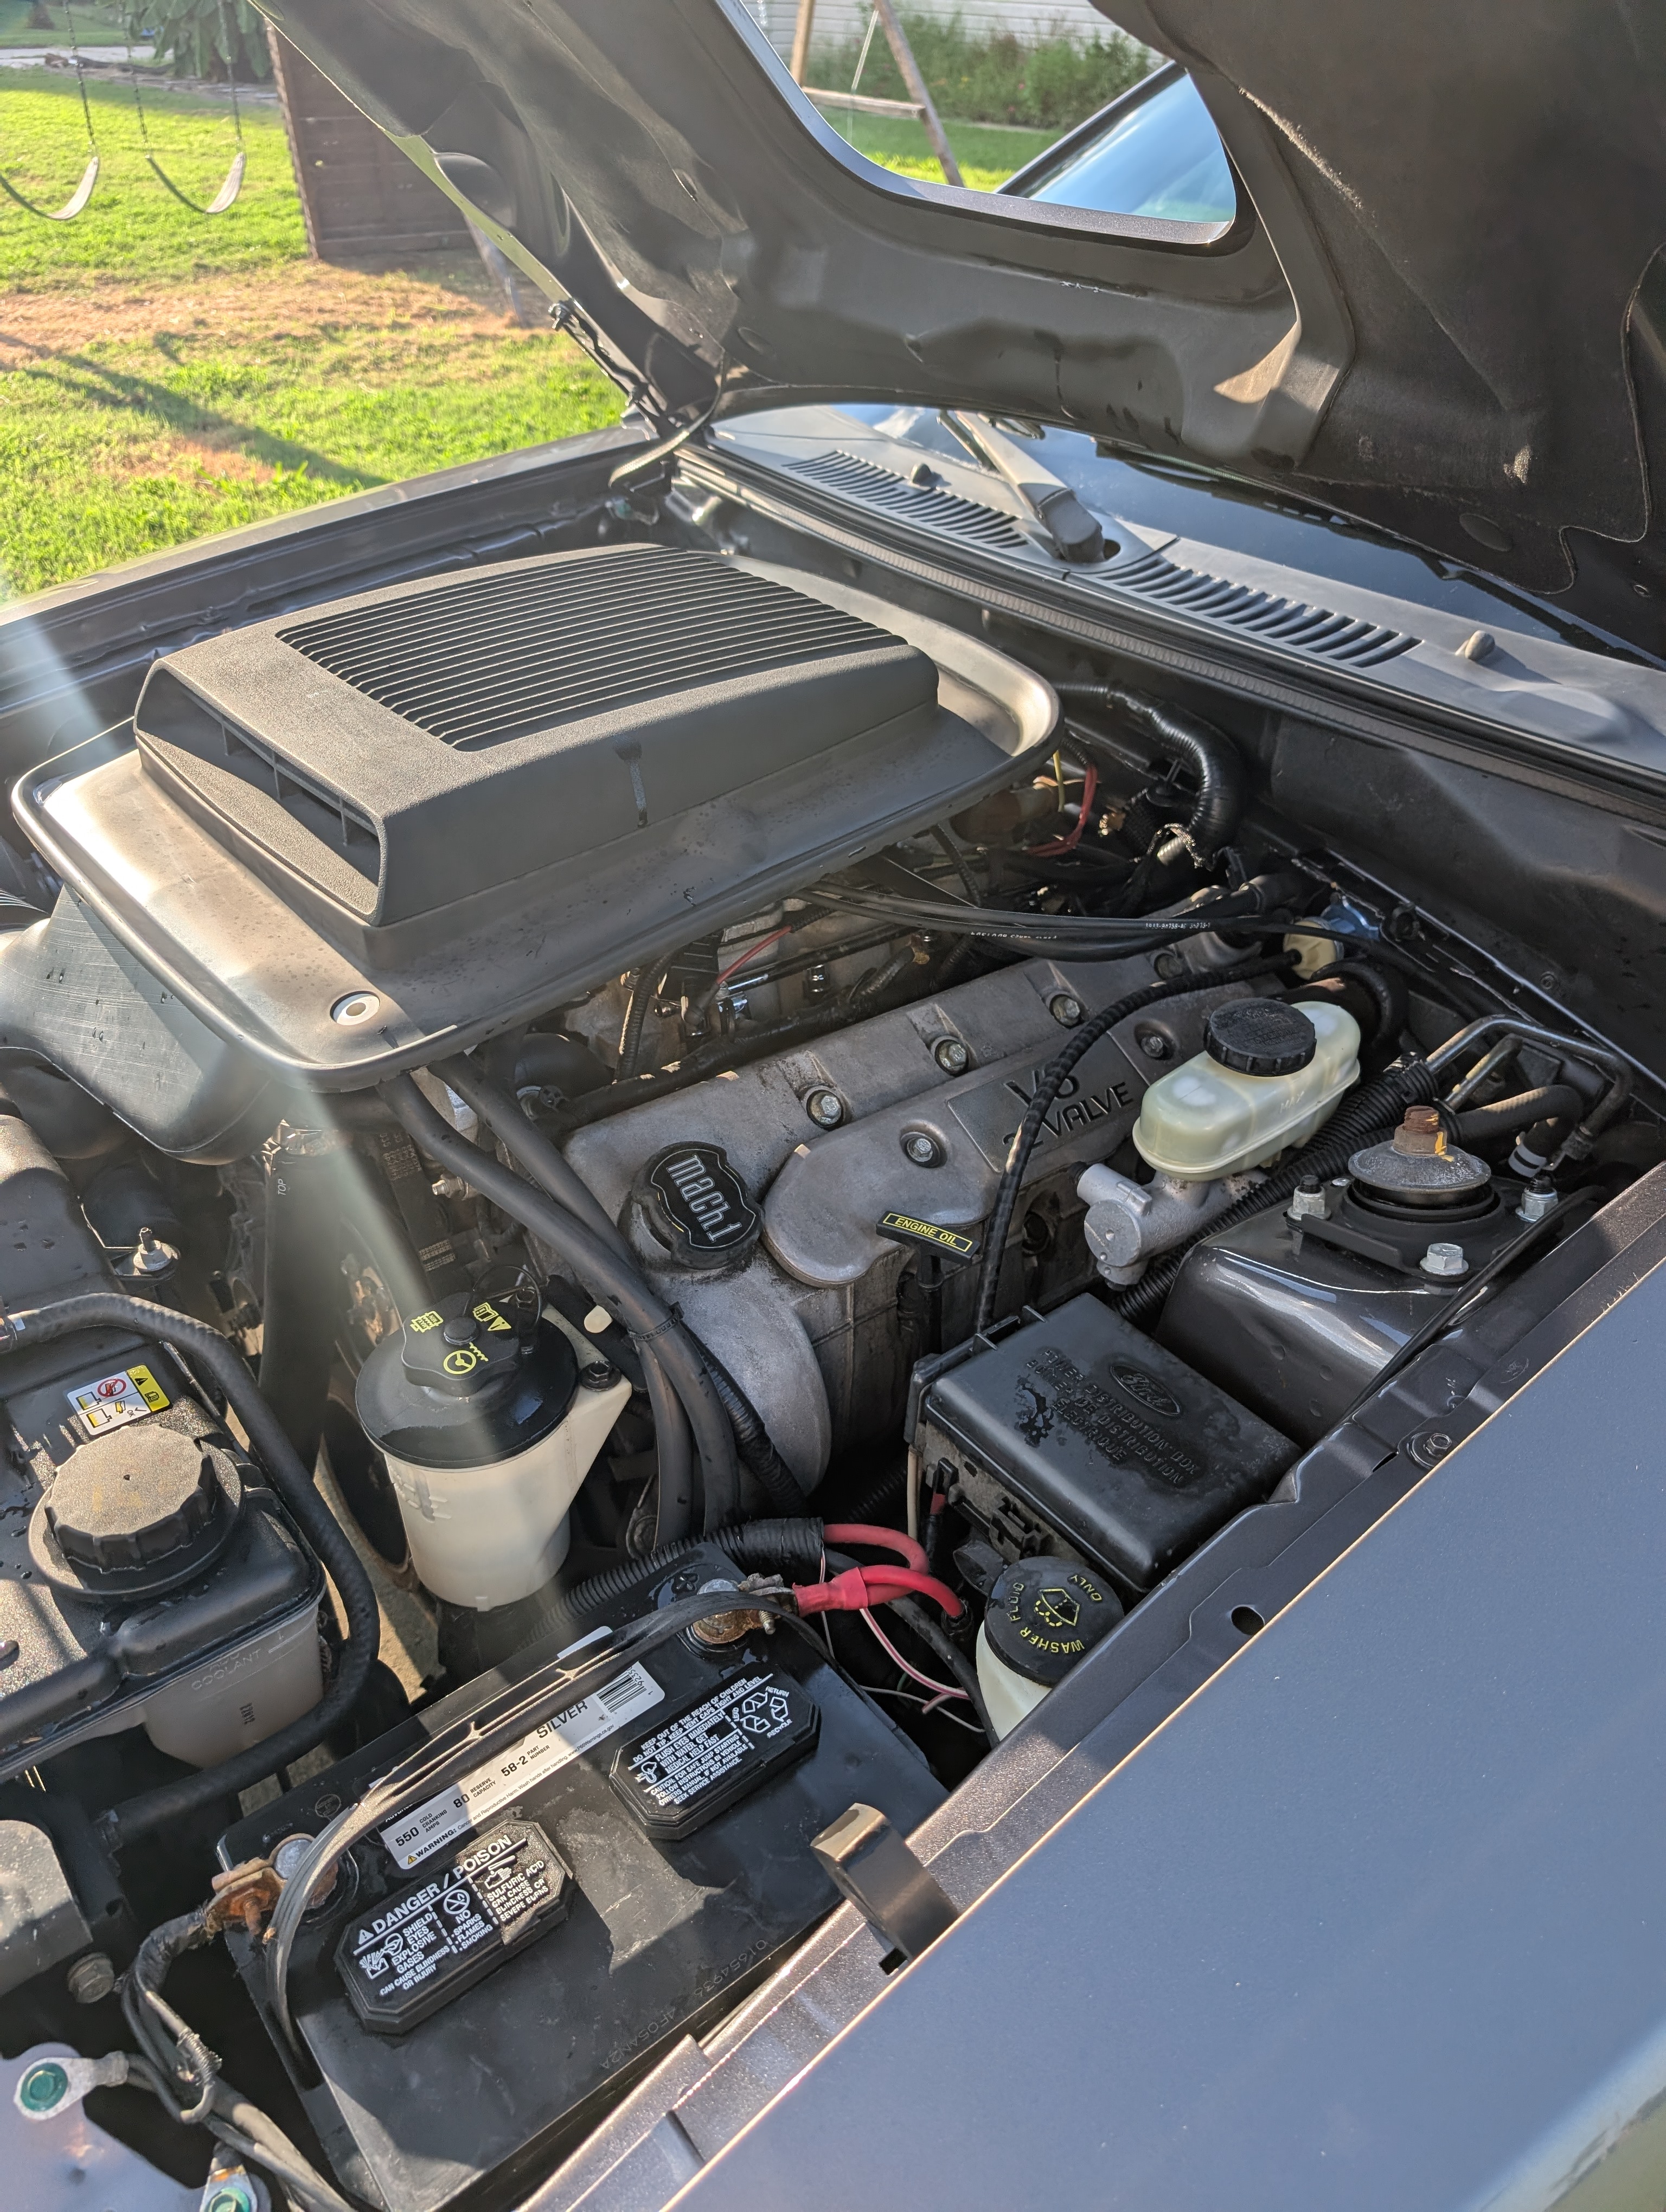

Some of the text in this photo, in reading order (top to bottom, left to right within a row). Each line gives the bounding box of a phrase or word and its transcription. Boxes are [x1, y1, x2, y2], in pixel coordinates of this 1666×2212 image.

[1040, 1082, 1133, 1137] VALVE
[275, 1178, 288, 1195] TOP
[894, 1216, 958, 1245] ENGINE OIL
[1121, 1373, 1170, 1406] Ford
[1045, 1349, 1084, 1381] POWER
[1169, 1449, 1199, 1476] BOX
[1006, 1574, 1101, 1653] WASHER FLUID ONLY
[191, 1650, 260, 1690] COOLANT
[765, 1686, 789, 1697] RETURN
[535, 1699, 588, 1740] SILVER
[632, 1753, 644, 1764] DO
[643, 1744, 657, 1757] NOT
[667, 1726, 684, 1740] KEEP
[683, 1716, 699, 1730] VENT
[698, 1706, 716, 1720] CAPS
[714, 1694, 733, 1709] TIGHT
[732, 1686, 745, 1698] AND
[744, 1674, 763, 1690] LEVEL
[640, 1677, 748, 1751] KEEP OUT OF THE REACH OF CHILDREN
[767, 1719, 792, 1738] RECYCLE
[527, 1745, 540, 1756] PART
[529, 1744, 550, 1760] NUMBER
[654, 1712, 726, 1763] FLUSH EYES IMMEDIATELY
[659, 1753, 676, 1768] WITH
[696, 1731, 710, 1744] GET
[500, 1754, 528, 1777] 58-2
[650, 1733, 740, 1796] CAUTION: FOR SAFE JUMP STARTING
[664, 1733, 721, 1774] MEDICAL HELP FAST
[703, 1768, 711, 1777] IF
[709, 1761, 722, 1773] NOT
[721, 1743, 749, 1765] AVAILABLE
[469, 1777, 492, 1794] RESERVE
[655, 1739, 743, 1801] FOLLOW INSTRUCTIONS IN VEHICLE
[672, 1755, 744, 1805] SEEK SERVICE ASSISTANCE.
[415, 1827, 458, 1857] WARNING:
[457, 1818, 472, 1830] Cancer
[472, 1812, 481, 1821] and
[480, 1795, 508, 1816] Reproductive
[517, 1780, 530, 1790] Wash
[529, 1771, 542, 1783] hands
[541, 1766, 551, 1774] after
[567, 1723, 616, 1758] www.P65Warnings.ca.gov
[452, 1792, 471, 1809] 80
[472, 1779, 497, 1798] CAPACITY
[418, 1812, 433, 1824] COLD
[421, 1808, 448, 1828] CRANKING
[424, 1820, 440, 1832] AMPS
[394, 1825, 420, 1847] 550
[371, 1881, 441, 1933] DANGER
[452, 1834, 513, 1880] POISON
[485, 1859, 545, 1902] SULFURIC ACID
[491, 1879, 530, 1908] CAN CAUSE
[533, 1877, 546, 1889] OR
[454, 1908, 472, 1924] NO
[498, 1884, 549, 1922] SEVERE BURNS
[401, 1912, 434, 1937] SHIELD
[406, 1925, 430, 1945] EYES
[390, 1931, 438, 1966] EXPLOSIVE
[395, 1950, 426, 1975] GASES
[379, 1945, 451, 1996] CAN CAUSE BLINDNESS
[401, 1962, 439, 1991] OR INJURY
